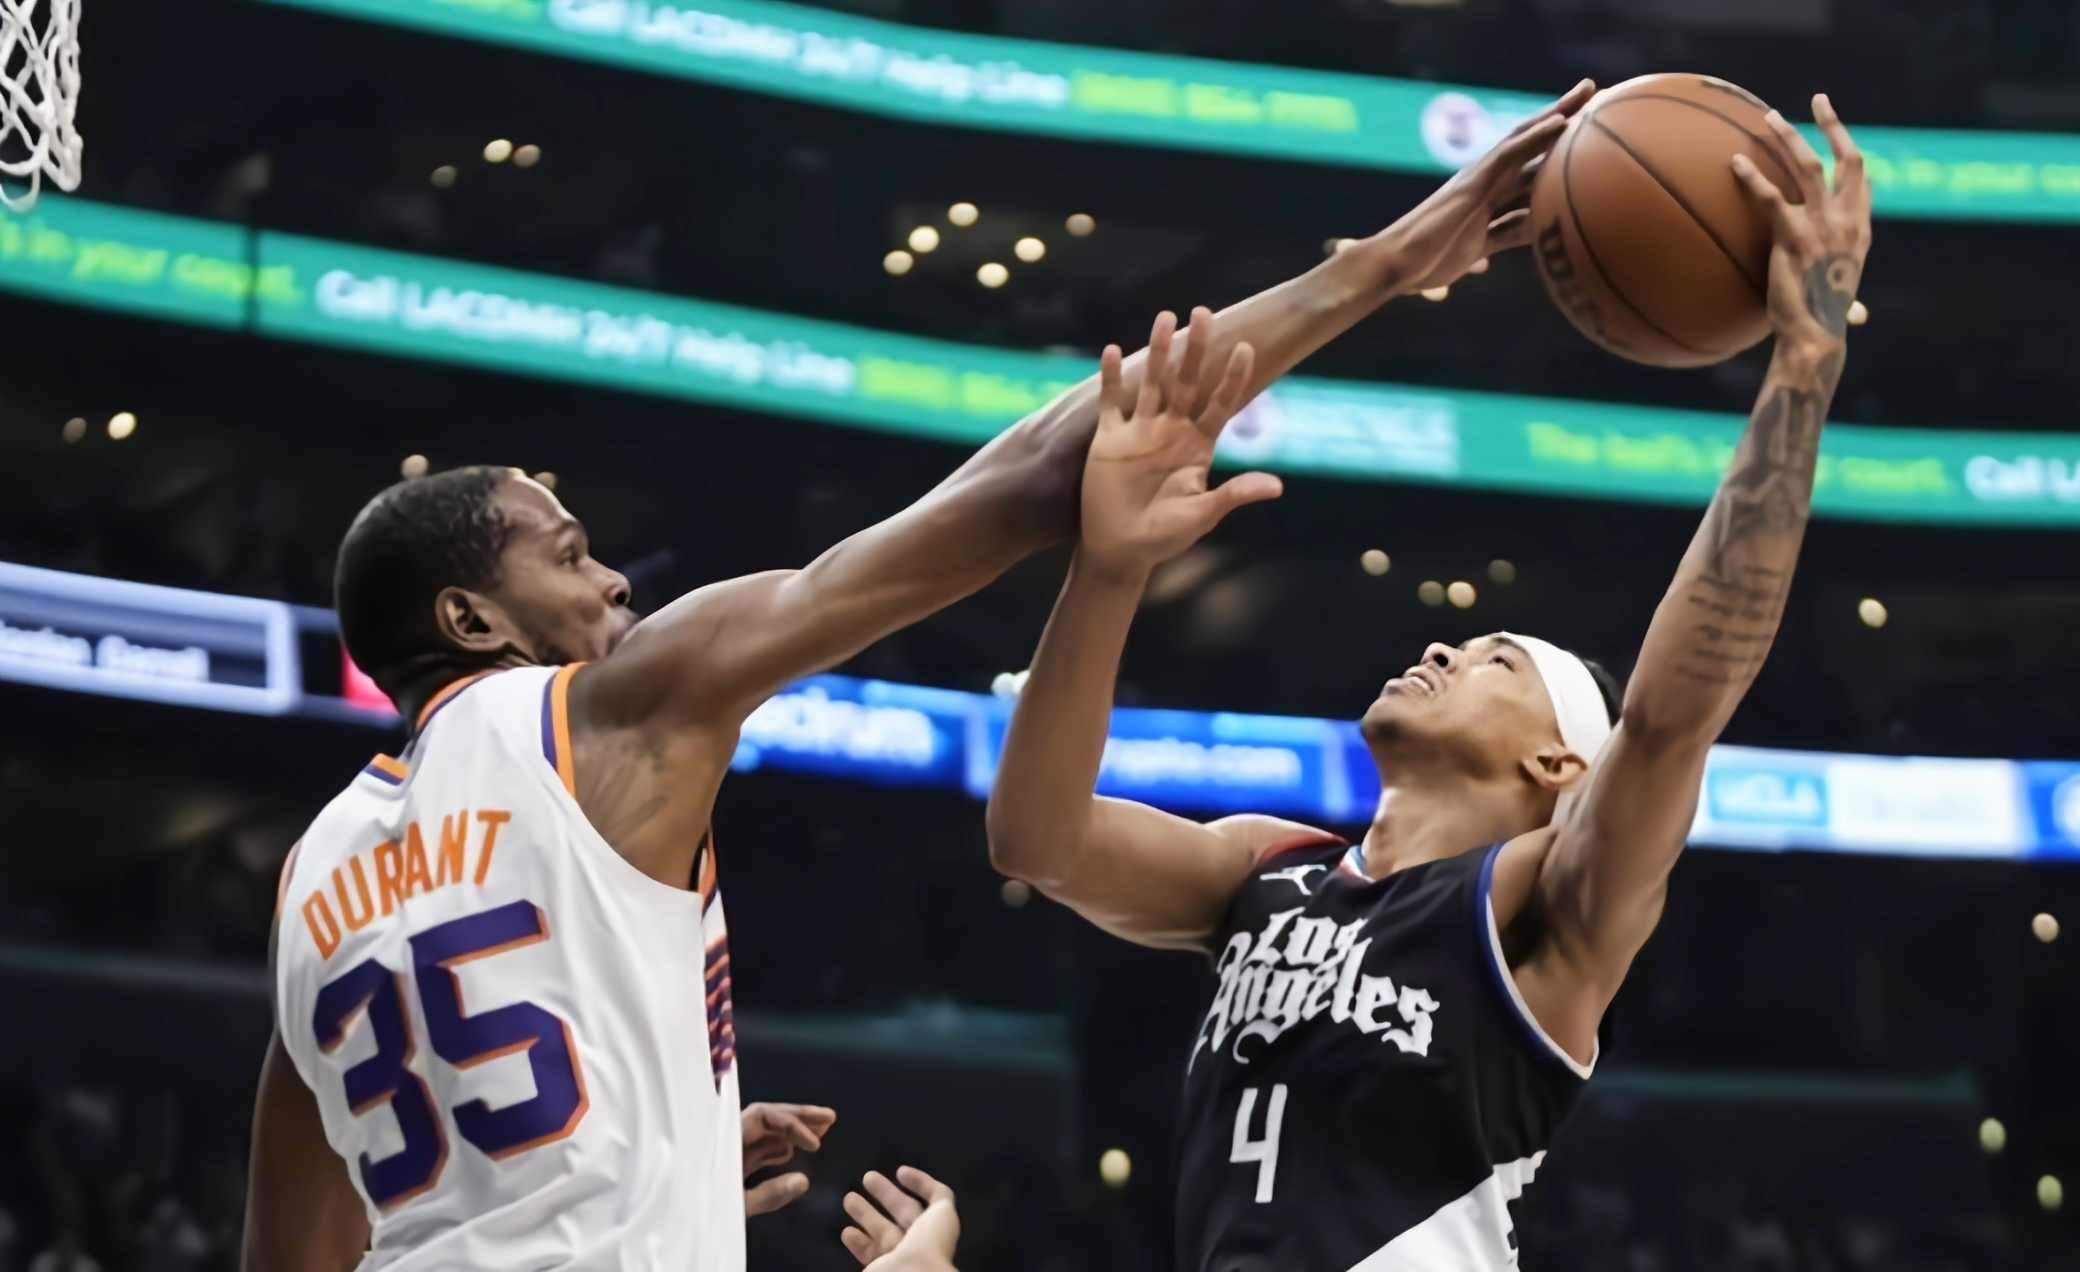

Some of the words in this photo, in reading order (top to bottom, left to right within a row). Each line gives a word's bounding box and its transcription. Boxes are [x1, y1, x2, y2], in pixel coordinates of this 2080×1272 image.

[302, 808, 512, 961] DURANT
[1246, 906, 1370, 972] Los
[312, 898, 590, 1212] 35
[1187, 931, 1441, 1076] Angeles
[1229, 1083, 1289, 1204] 4
